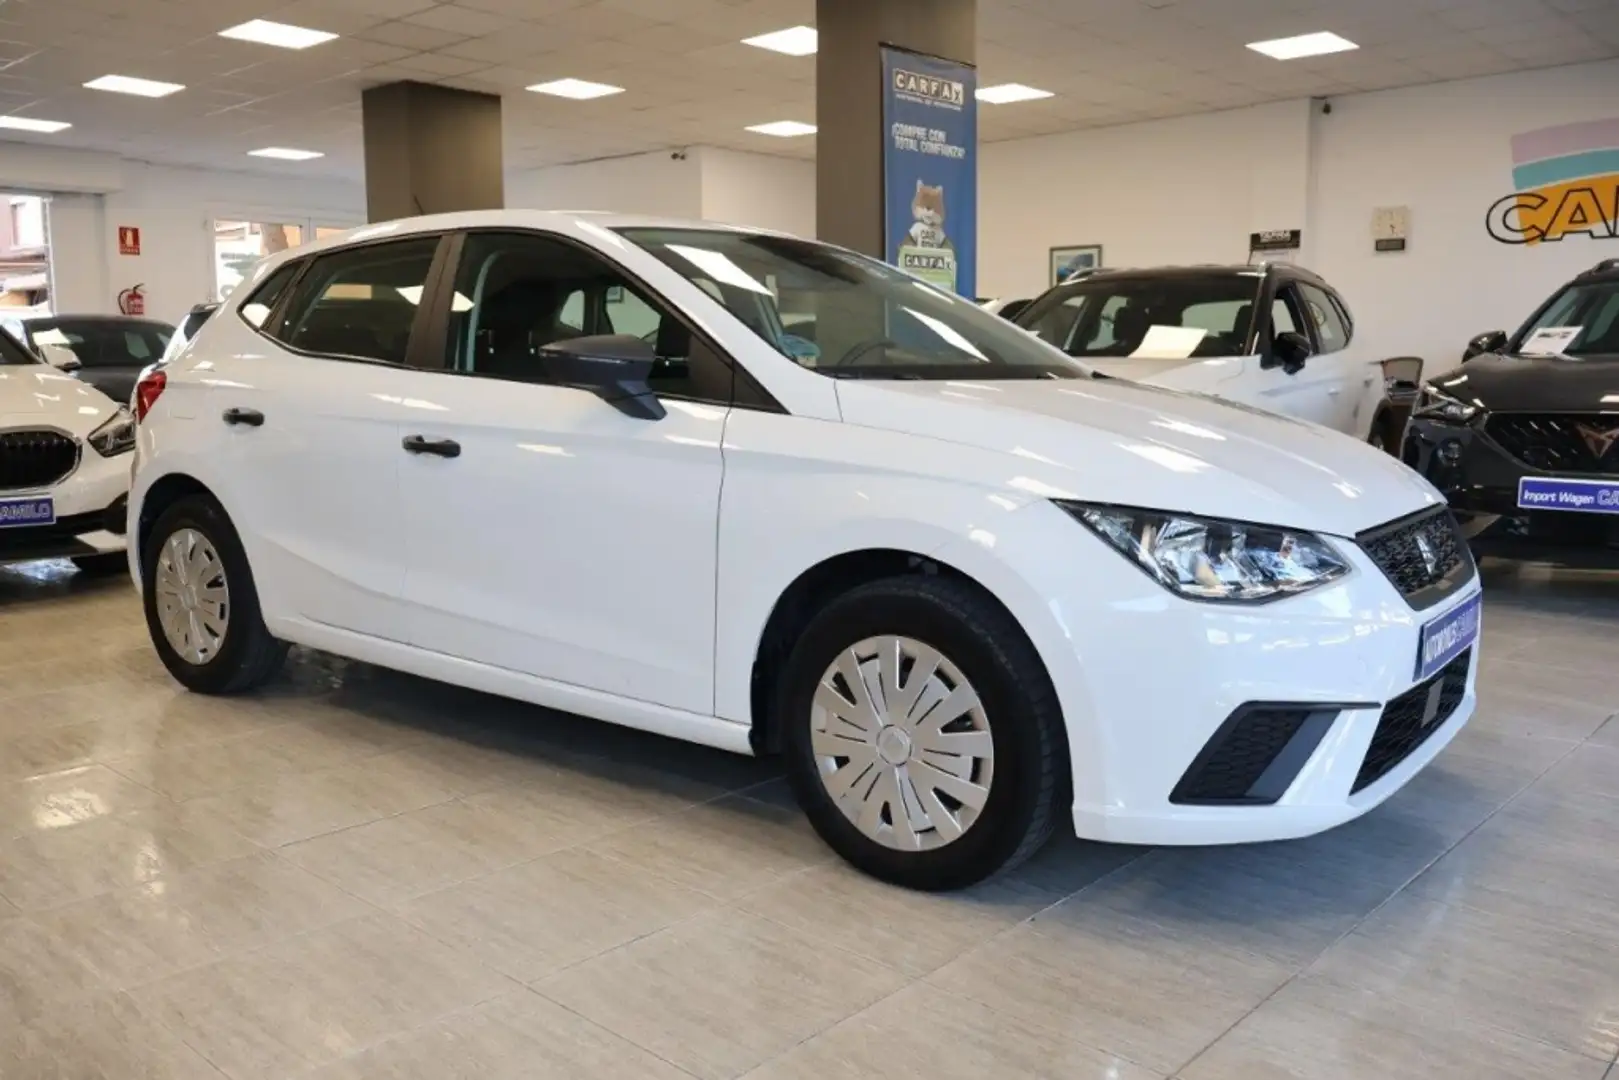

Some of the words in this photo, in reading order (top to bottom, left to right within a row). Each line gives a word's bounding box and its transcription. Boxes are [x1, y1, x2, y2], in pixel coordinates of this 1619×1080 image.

[894, 71, 963, 105] CARFAX
[1486, 185, 1619, 244] CA
[1524, 489, 1557, 503] Import
[1559, 491, 1595, 506] Wagen
